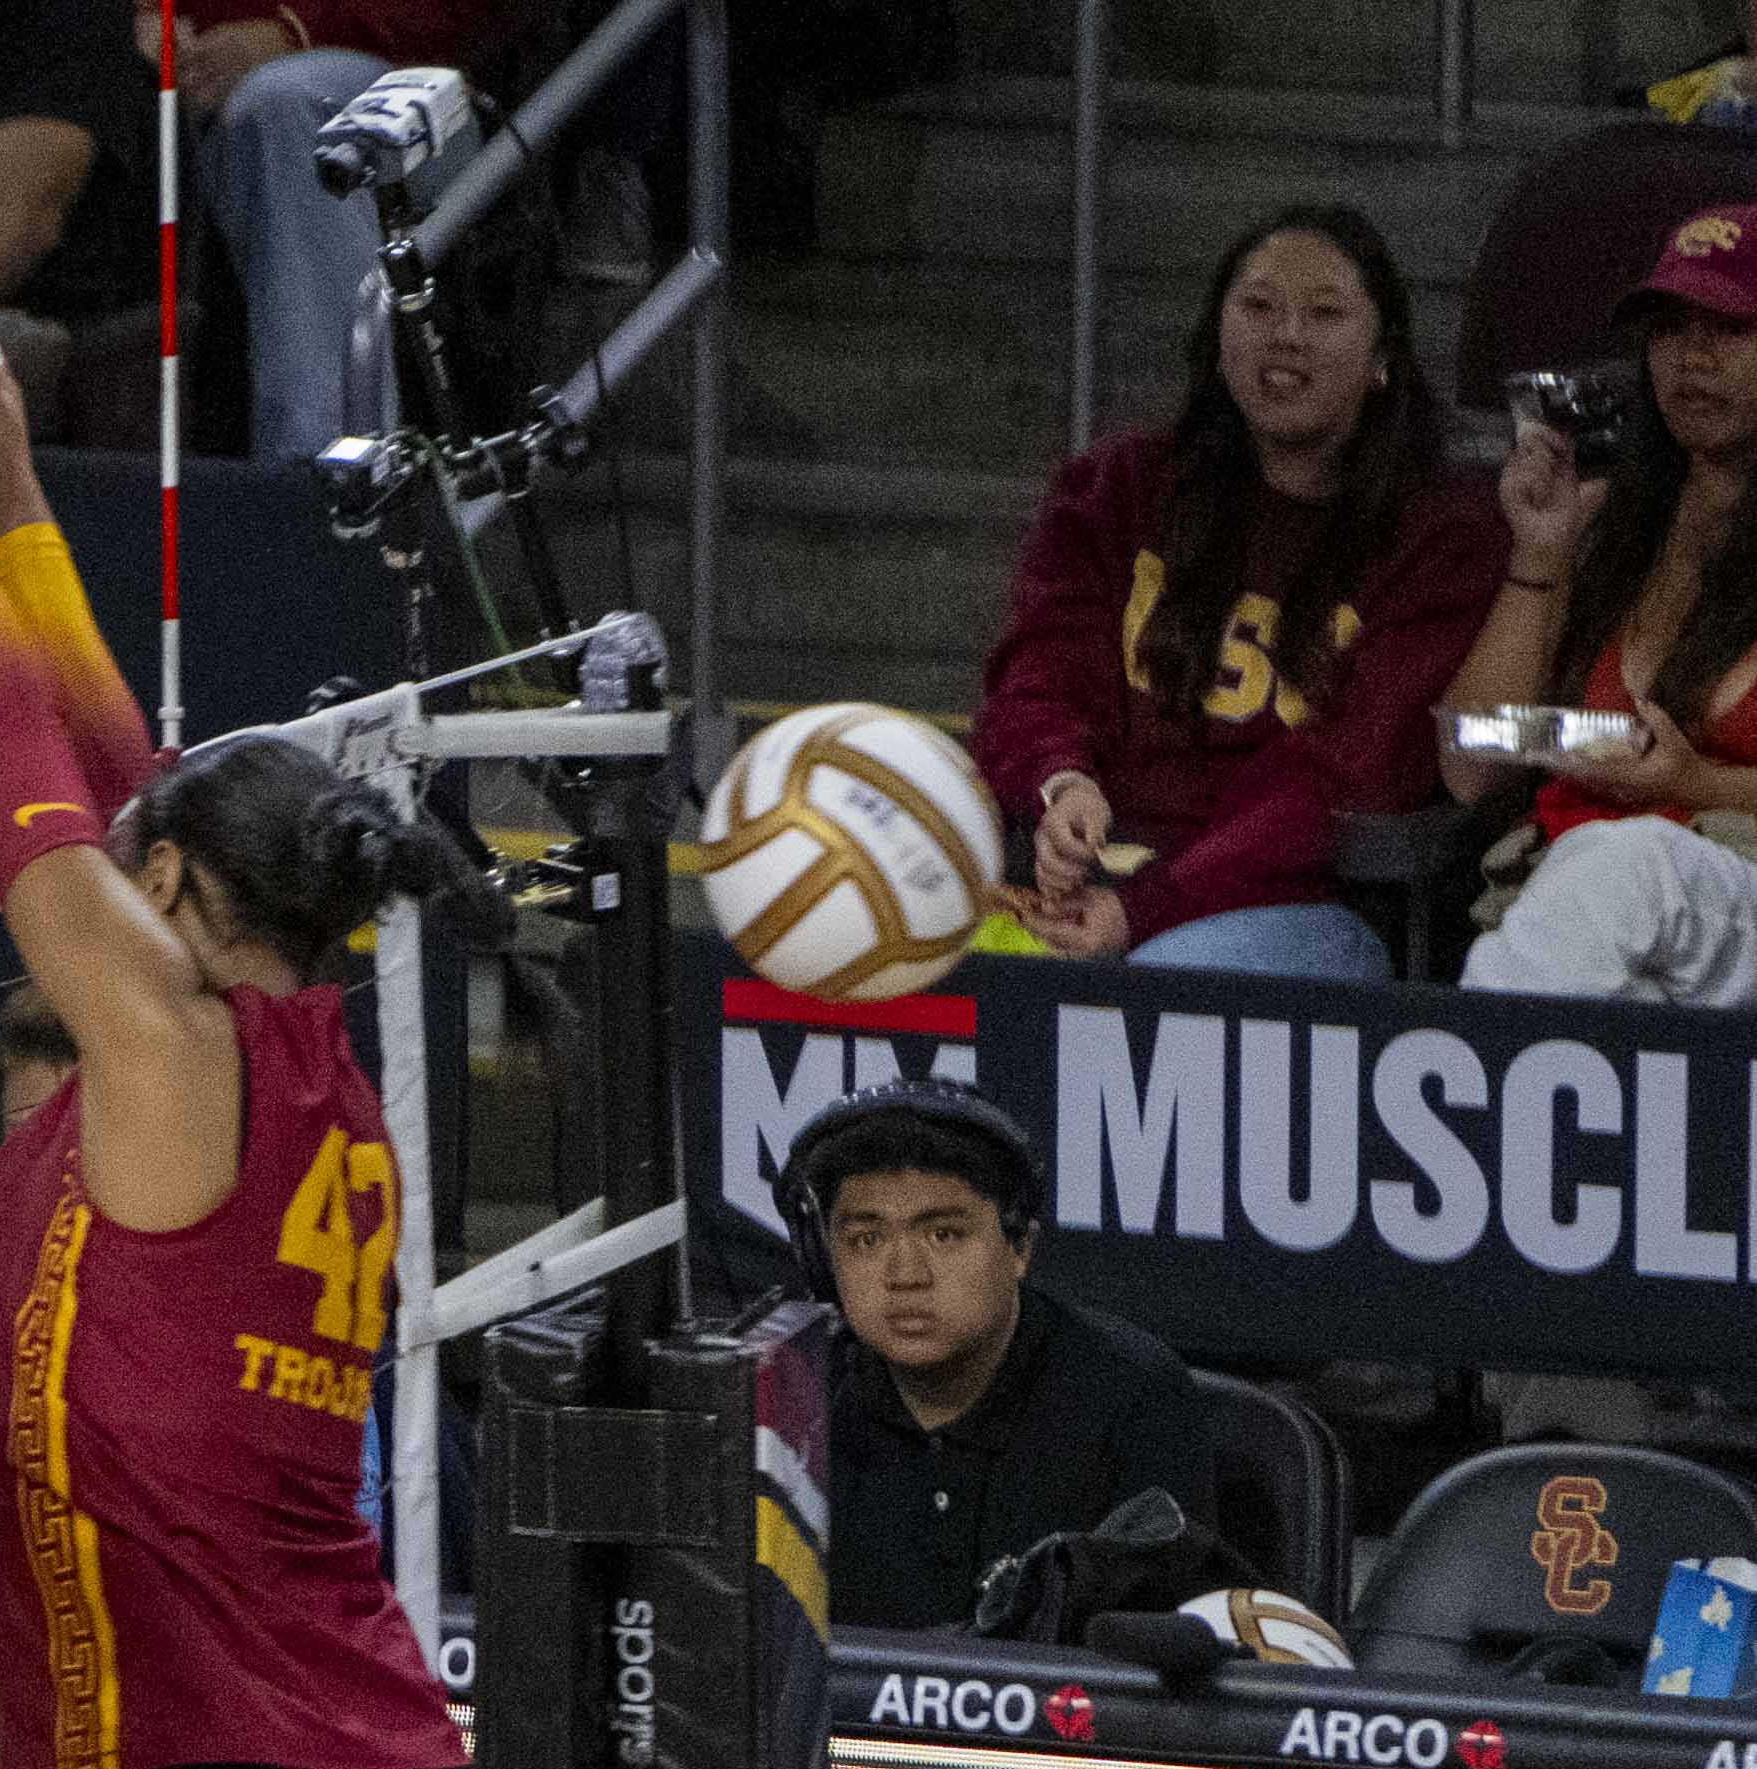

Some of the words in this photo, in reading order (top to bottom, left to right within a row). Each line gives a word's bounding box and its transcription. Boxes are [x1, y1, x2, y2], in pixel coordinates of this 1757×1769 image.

[1055, 1002, 1757, 1285] MUSCL
[870, 1673, 1036, 1734] ARCO
[1281, 1707, 1448, 1768] ARCO
